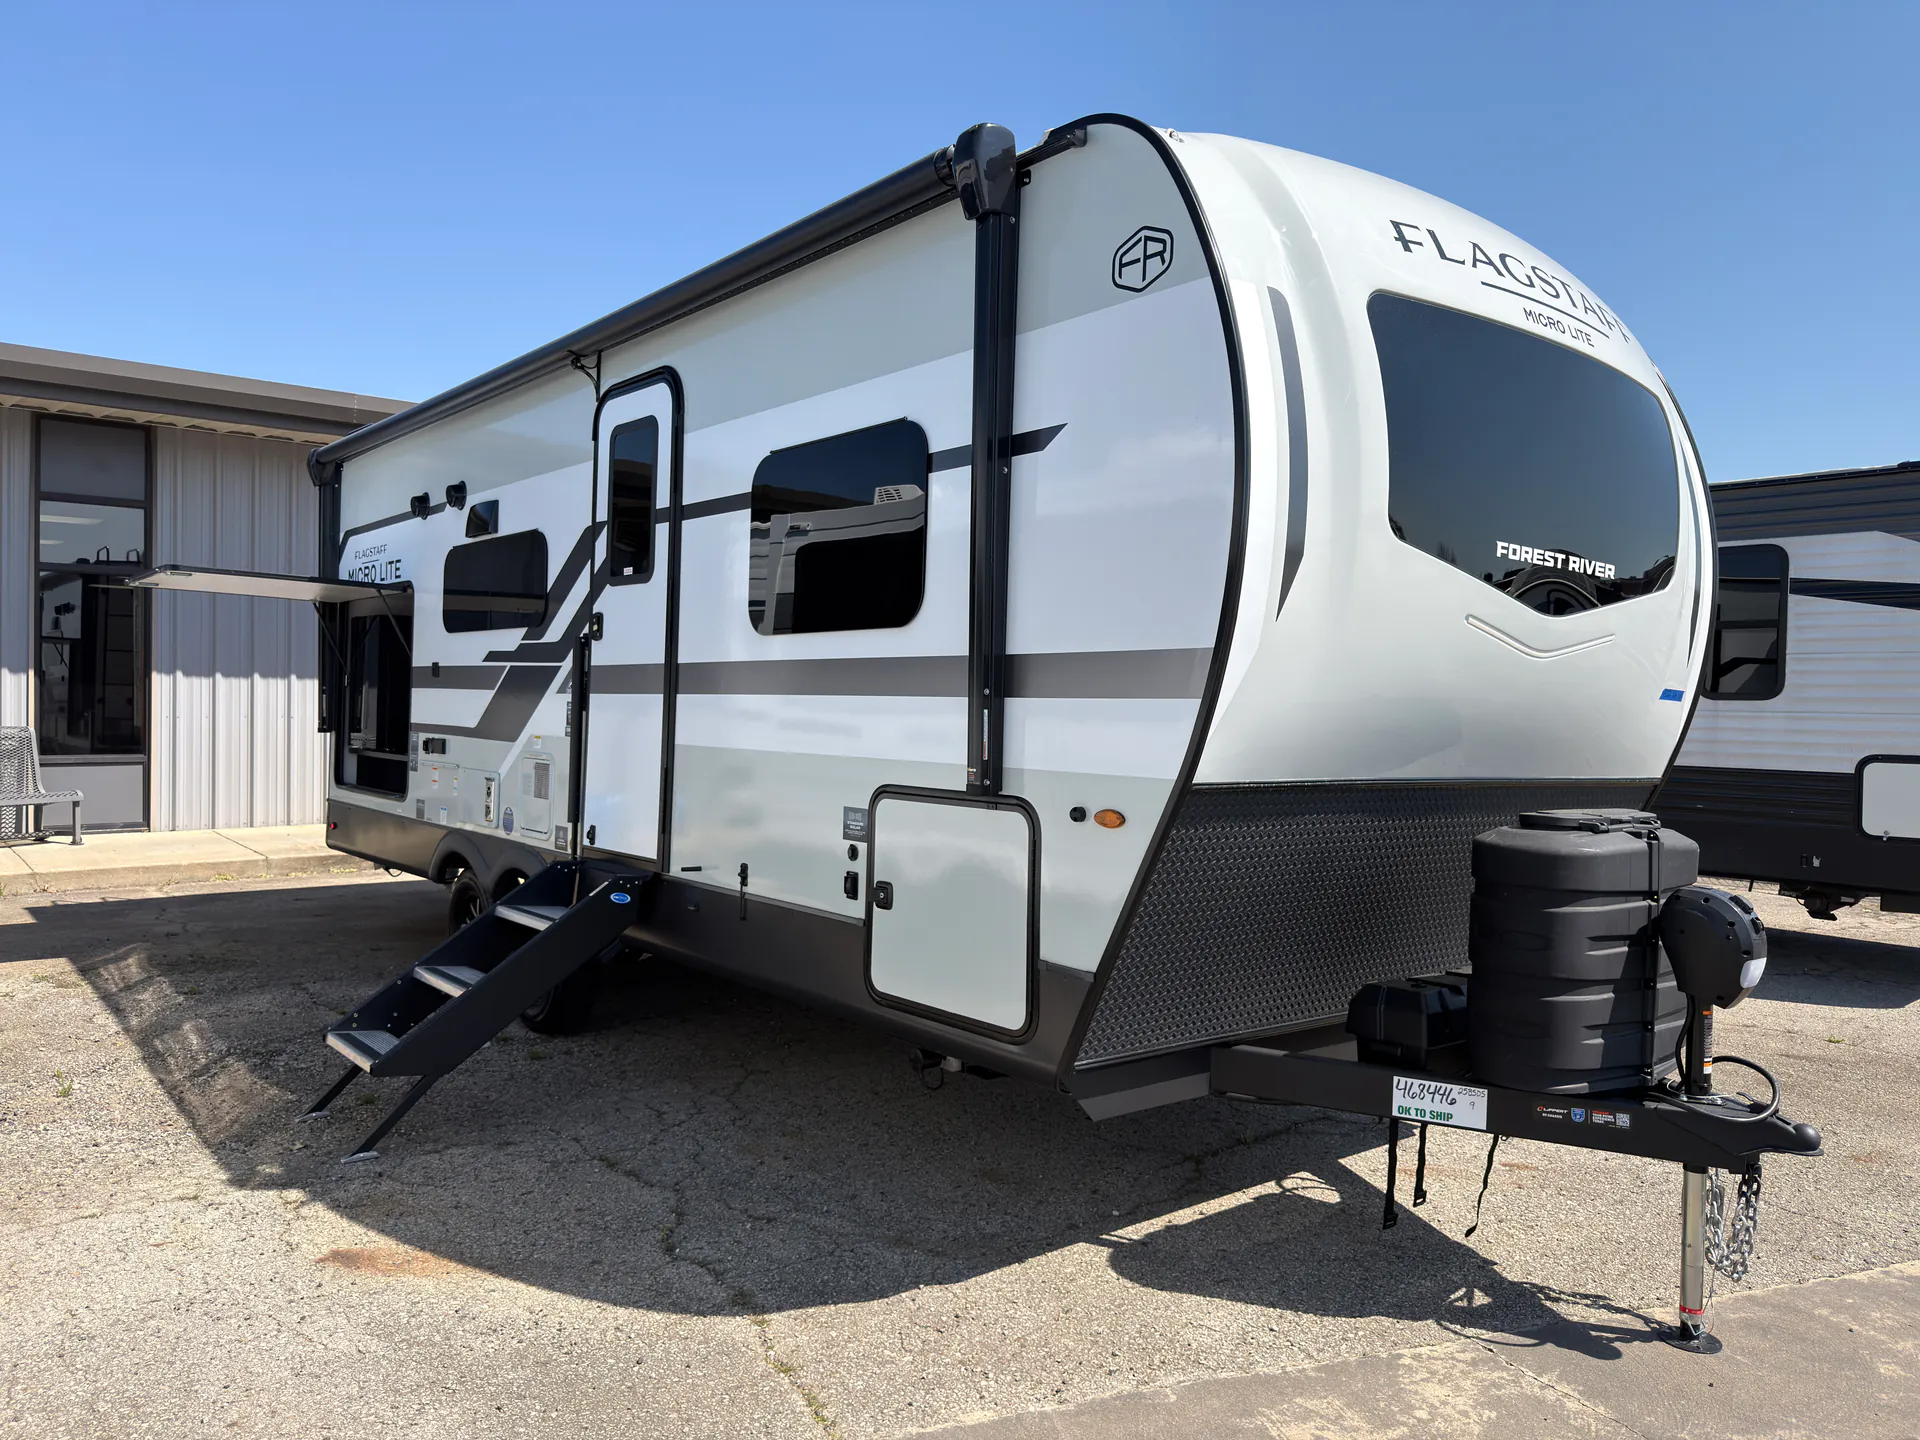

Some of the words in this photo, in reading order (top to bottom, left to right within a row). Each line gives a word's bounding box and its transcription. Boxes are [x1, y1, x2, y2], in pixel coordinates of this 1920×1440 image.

[1389, 219, 1632, 344] FLAGSTAFF
[1523, 307, 1565, 335] MICRO
[1568, 325, 1595, 347] LITE
[355, 544, 387, 560] FLAGSTAFF
[1496, 540, 1566, 569] FOREST
[1568, 555, 1616, 580] RIVER
[348, 564, 377, 583] MICRO
[380, 559, 402, 582] LITE
[1395, 1078, 1457, 1106] 468446
[1397, 1105, 1412, 1116] OK
[1414, 1107, 1427, 1119] TO
[1429, 1110, 1454, 1122] SHIP
